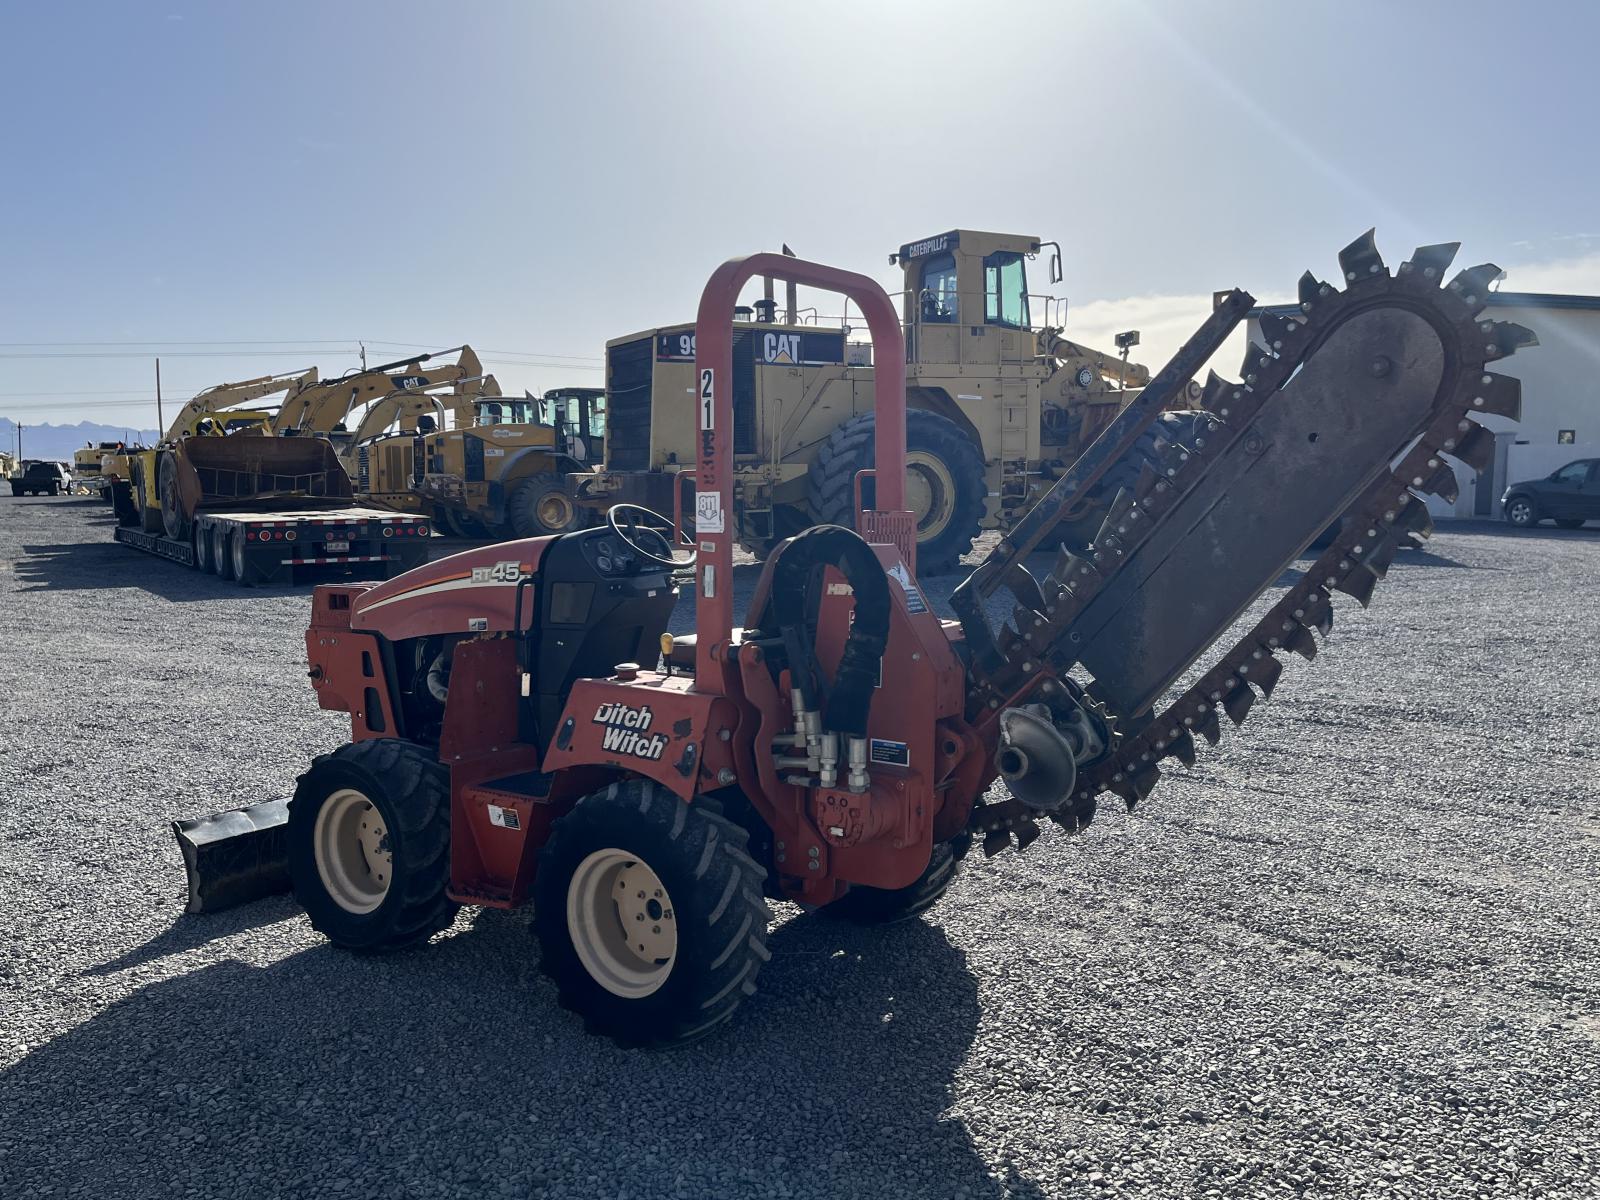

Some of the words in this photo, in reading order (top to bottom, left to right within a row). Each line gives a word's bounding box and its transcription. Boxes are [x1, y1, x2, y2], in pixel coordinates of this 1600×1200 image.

[679, 335, 695, 355] 9
[763, 333, 800, 364] CAT
[403, 377, 419, 389] CAT
[593, 702, 652, 730] Ditch
[602, 727, 664, 759] Witch
